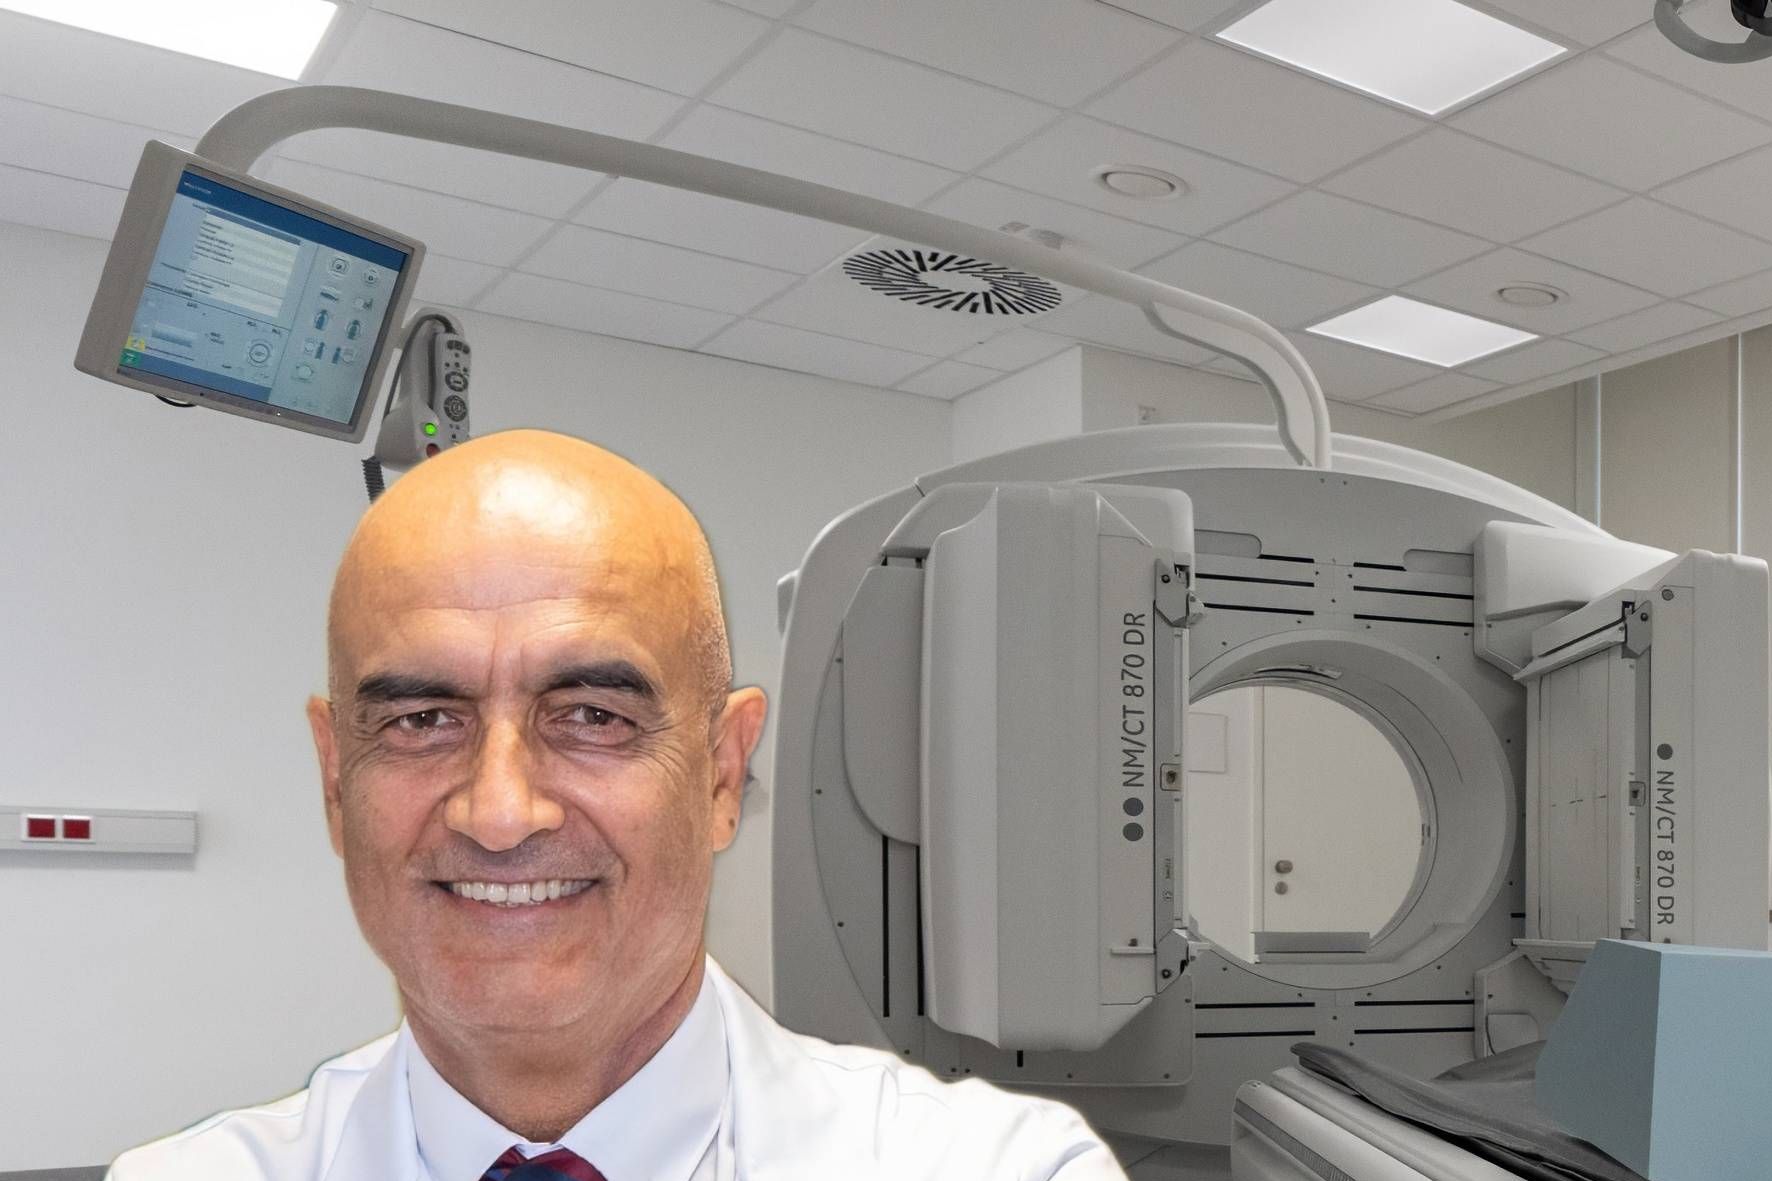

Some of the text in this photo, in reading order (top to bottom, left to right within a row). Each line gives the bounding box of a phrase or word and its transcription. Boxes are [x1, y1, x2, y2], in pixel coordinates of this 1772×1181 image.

[1121, 612, 1147, 787] NM/CT 870 DR
[1655, 770, 1676, 925] NM/CT 870 DR
